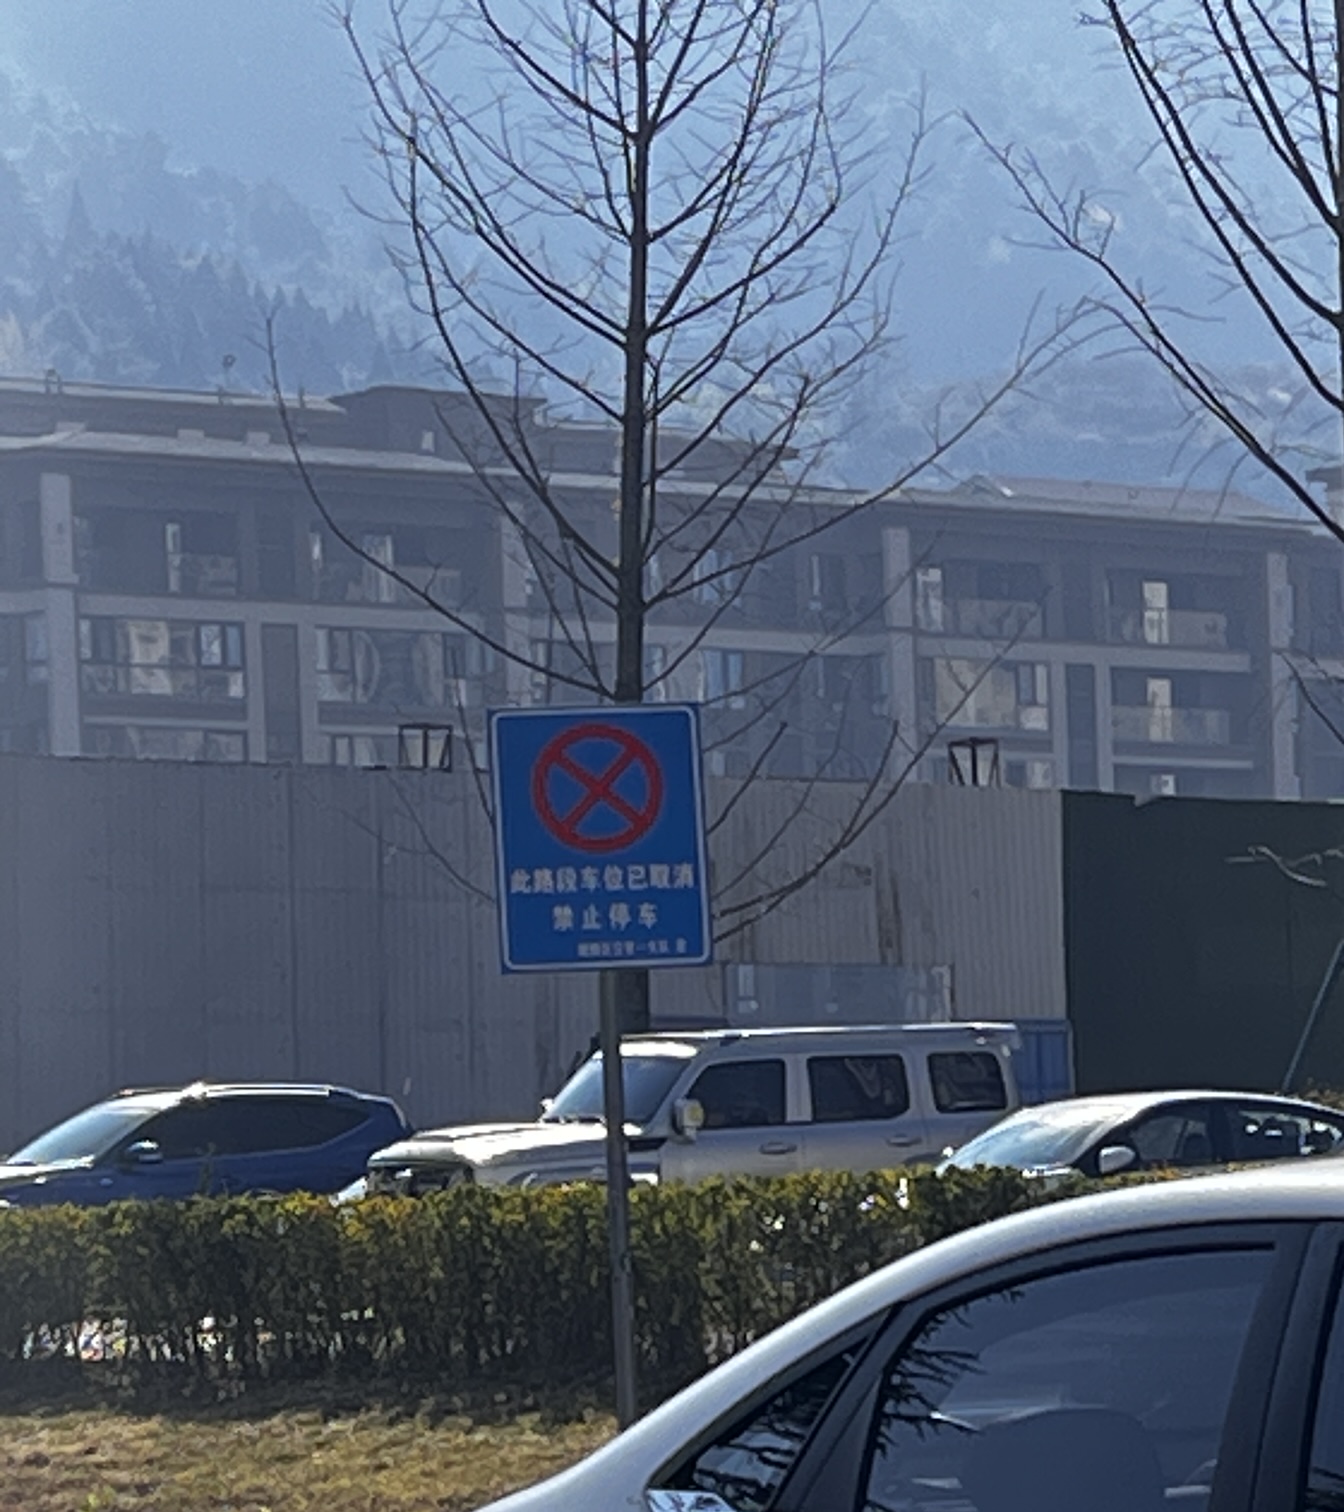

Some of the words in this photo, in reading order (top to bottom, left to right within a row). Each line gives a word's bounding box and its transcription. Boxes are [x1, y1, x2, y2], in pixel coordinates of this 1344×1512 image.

[511, 864, 694, 893] 此路段车位已取消
[553, 902, 657, 930] 禁止停车
